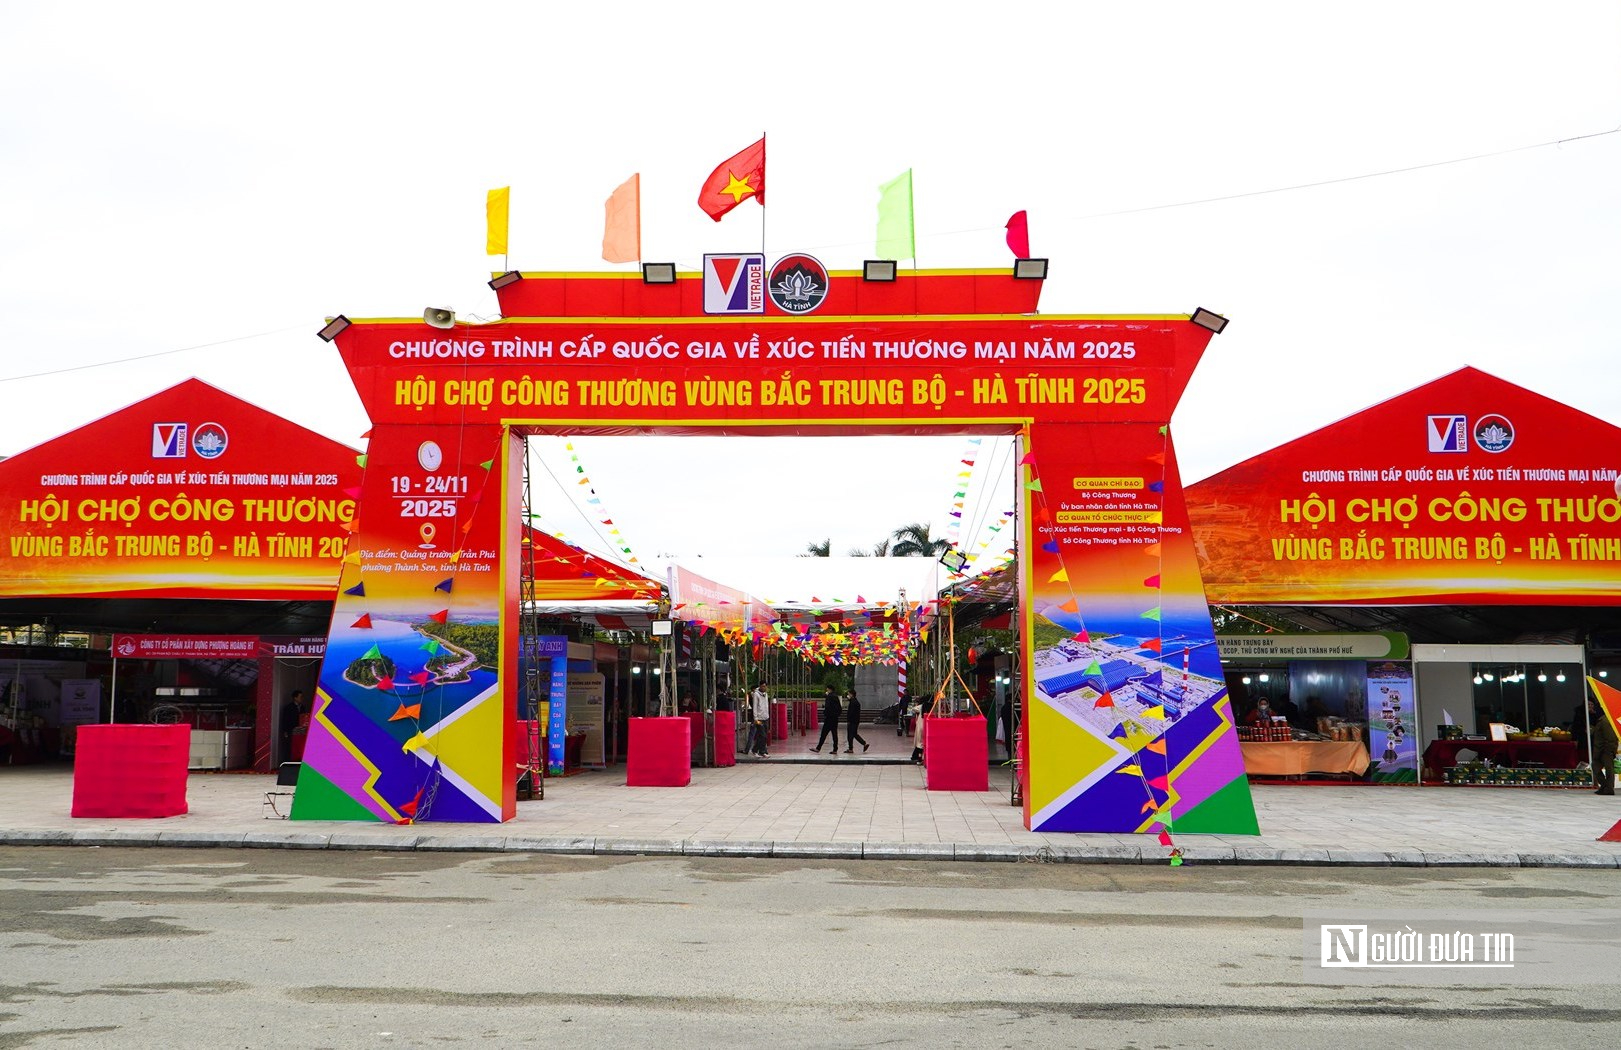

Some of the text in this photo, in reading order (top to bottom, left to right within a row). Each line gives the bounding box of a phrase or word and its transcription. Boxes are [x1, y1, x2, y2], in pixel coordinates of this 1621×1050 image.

[751, 266, 760, 310] VIETRADE
[782, 300, 812, 310] HÀ TĨNH
[388, 333, 1137, 363] CHƯƠNG TRÌNH CẤP QUỐC GIA VỀ XÚC TIẾN THƯƠNG MẠI NĂM 2025
[395, 375, 436, 411] HỘI
[443, 377, 494, 410] CHỢ
[500, 375, 568, 406] CÔNG
[577, 378, 676, 406] THƯƠNG
[685, 376, 752, 406] VÙNG
[761, 371, 811, 405] BẮC
[819, 378, 904, 405] TRUNG
[913, 374, 946, 410] BỘ
[973, 373, 1008, 404] HÀ
[1014, 373, 1075, 404] TĨNH
[1083, 378, 1146, 404] 2025
[41, 470, 338, 488] CHƯƠNG TRÌNH CẤP QUỐC GIA VỀ XÚC TIẾN THƯƠNG MẠI NĂM 2025
[1302, 466, 1617, 484] CHƯƠNG TRÌNH CẤP QUỐC GIA VỀ XÚC TIẾN THƯƠNG MẠI NĂM
[391, 476, 410, 493] 19
[425, 475, 468, 493] 24/11
[1082, 492, 1137, 500] Bộ Công Thương
[20, 493, 356, 528] HỘI CHỢ CÔNG THƯƠNG
[400, 500, 457, 517] 2025
[1280, 493, 1336, 529] HỘI
[1346, 495, 1418, 528] CHỢ
[1428, 491, 1527, 522] CÔNG
[1083, 526, 1108, 534] Thương
[1138, 526, 1156, 534] Công
[1157, 526, 1182, 534] Thương
[10, 533, 63, 557] VÙNG
[69, 528, 108, 557] BẮC
[115, 536, 181, 557] TRUNG
[186, 531, 214, 561] BỘ
[234, 531, 261, 558] HÀ
[267, 533, 313, 558] TĨNH
[318, 536, 349, 558] 20
[1073, 537, 1092, 545] Công
[1271, 534, 1333, 560] VÙNG
[1340, 529, 1385, 560] BẮC
[1392, 537, 1468, 560] TRUNG
[1476, 532, 1506, 565] BỘ
[1529, 533, 1561, 560] HÀ
[1567, 534, 1621, 560] TĨNH
[360, 549, 496, 560] Địa điểm: Quảng trườn Trần Phú
[360, 563, 392, 573] phường
[394, 563, 419, 572] Thành
[420, 563, 438, 572] Sen,
[459, 563, 471, 572] Hà
[473, 563, 491, 572] Tĩnh
[155, 641, 161, 649] TY
[1226, 638, 1242, 646] HÀNG
[1262, 638, 1274, 646] BÀY
[1253, 646, 1268, 654] CÔNG
[1280, 646, 1295, 655] NGHỆ
[1295, 646, 1308, 654] CỦA
[1308, 646, 1328, 654] THÀNH
[1341, 645, 1353, 654] HUẾ
